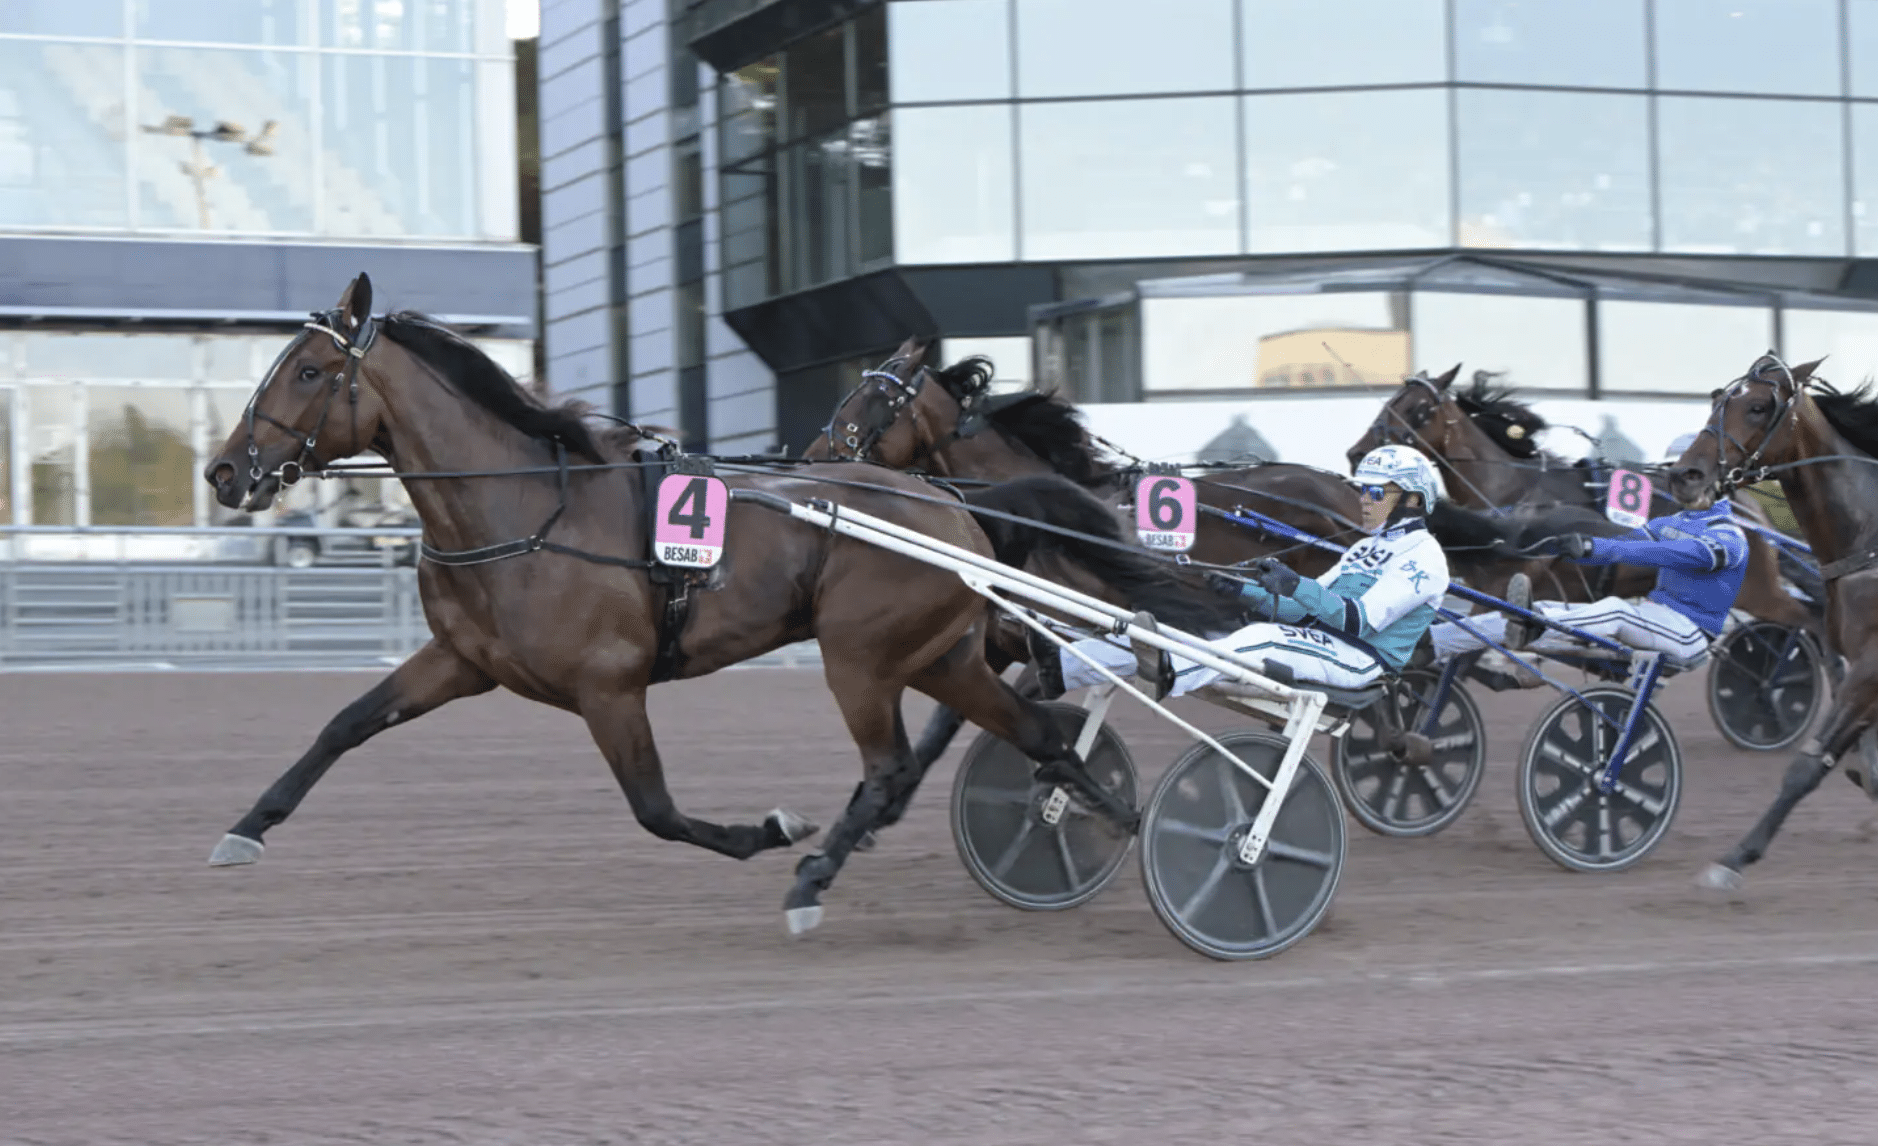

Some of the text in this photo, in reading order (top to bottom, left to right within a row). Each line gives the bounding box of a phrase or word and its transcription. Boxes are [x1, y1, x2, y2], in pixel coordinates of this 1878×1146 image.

[668, 478, 710, 540] 4
[1148, 479, 1183, 531] 6
[1618, 473, 1642, 512] 8
[664, 546, 698, 562] BESAB
[1278, 625, 1335, 649] SVEA
